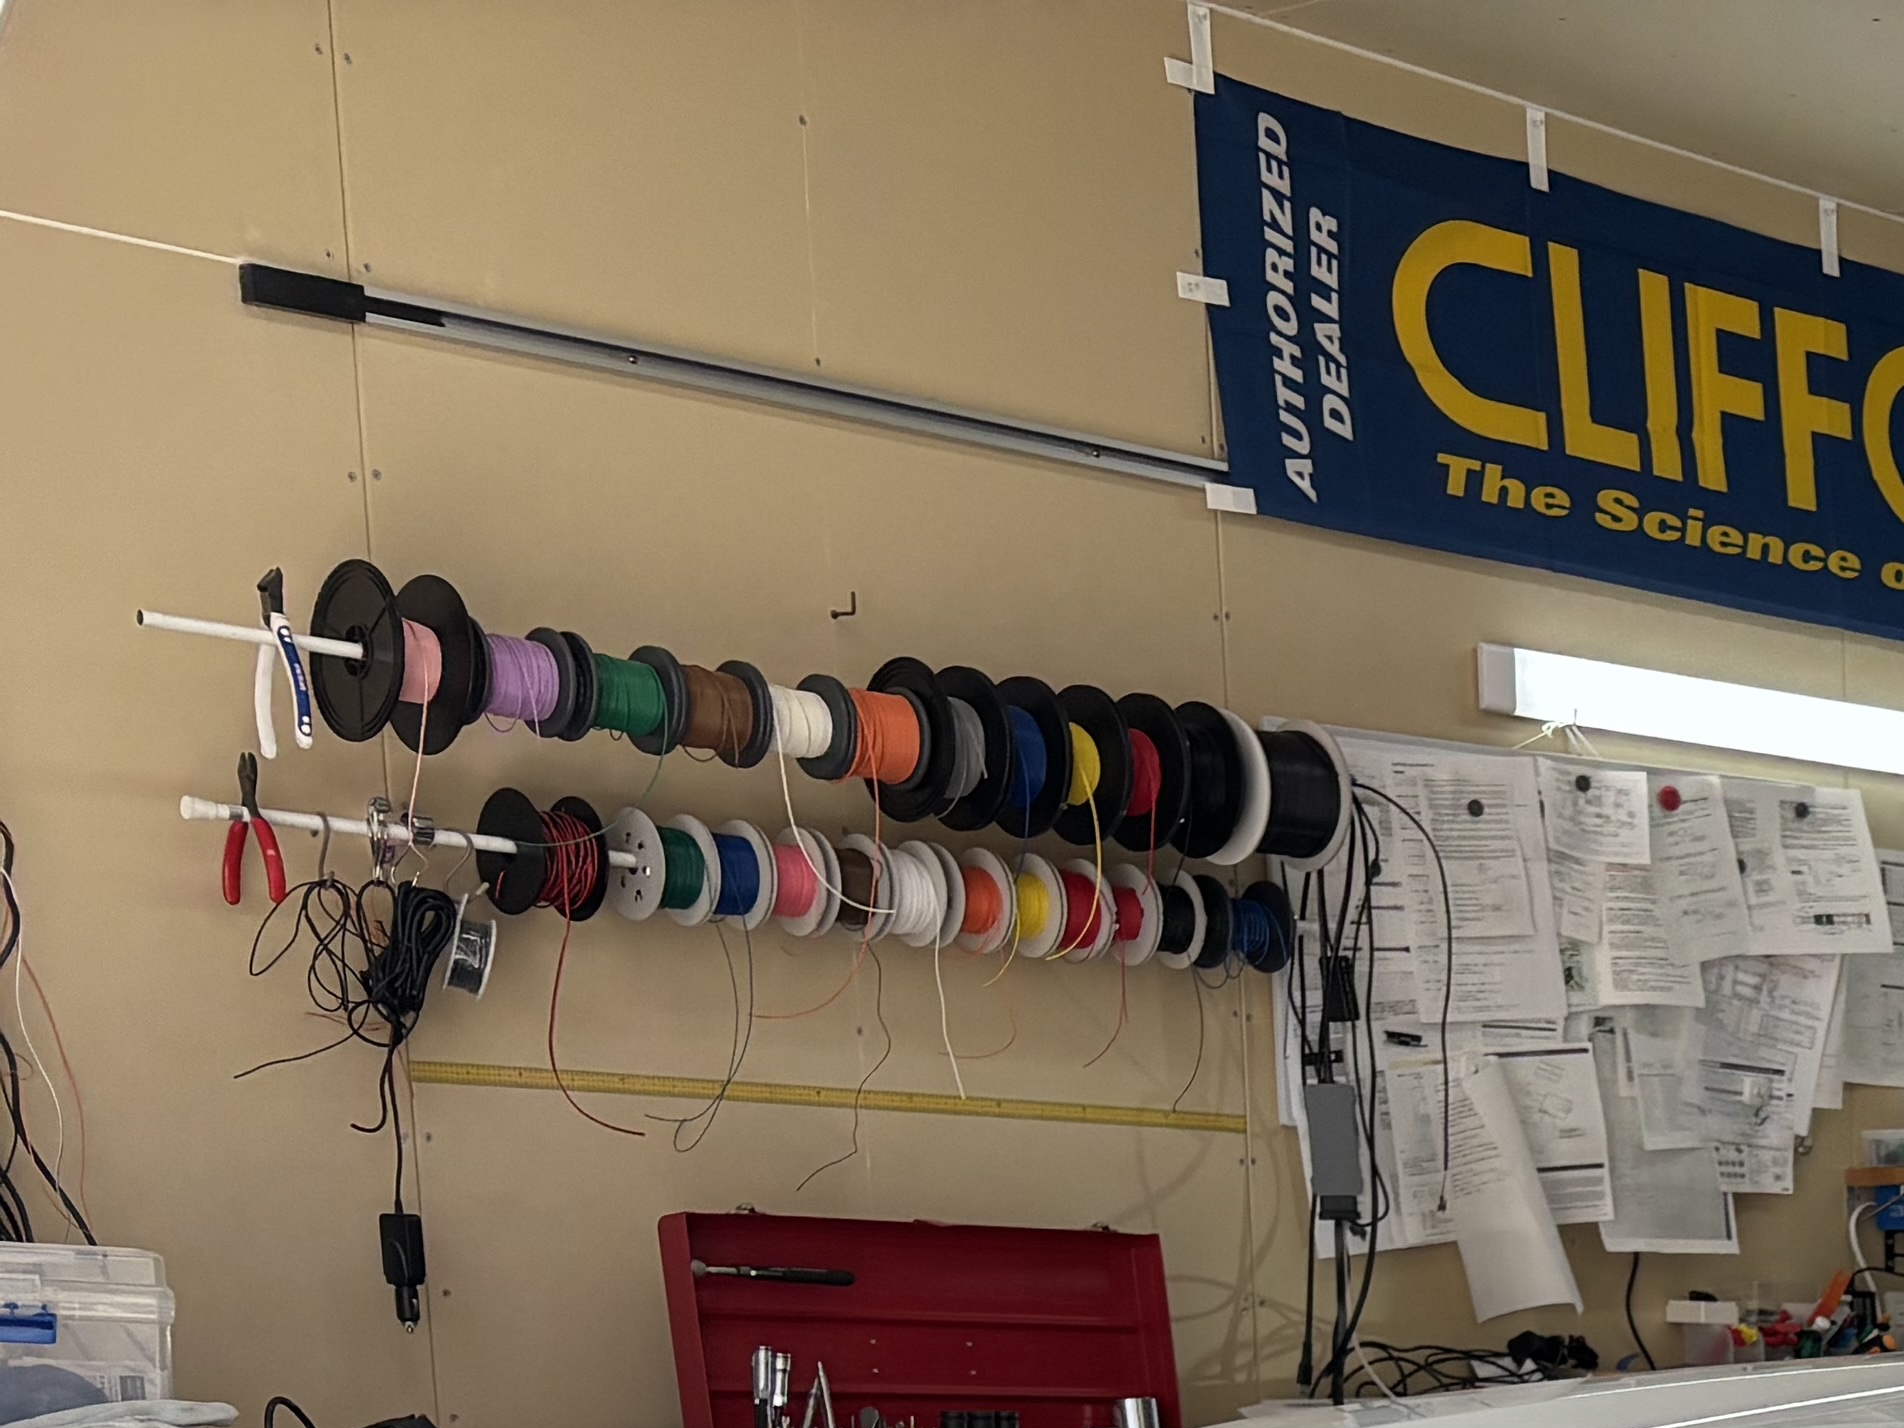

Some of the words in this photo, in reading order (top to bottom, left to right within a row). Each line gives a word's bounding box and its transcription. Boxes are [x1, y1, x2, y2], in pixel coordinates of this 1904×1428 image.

[1257, 112, 1318, 503] AUTHORIZED
[1308, 206, 1354, 441] DEALER
[1436, 453, 1571, 518] The
[1594, 489, 1861, 580] Science
